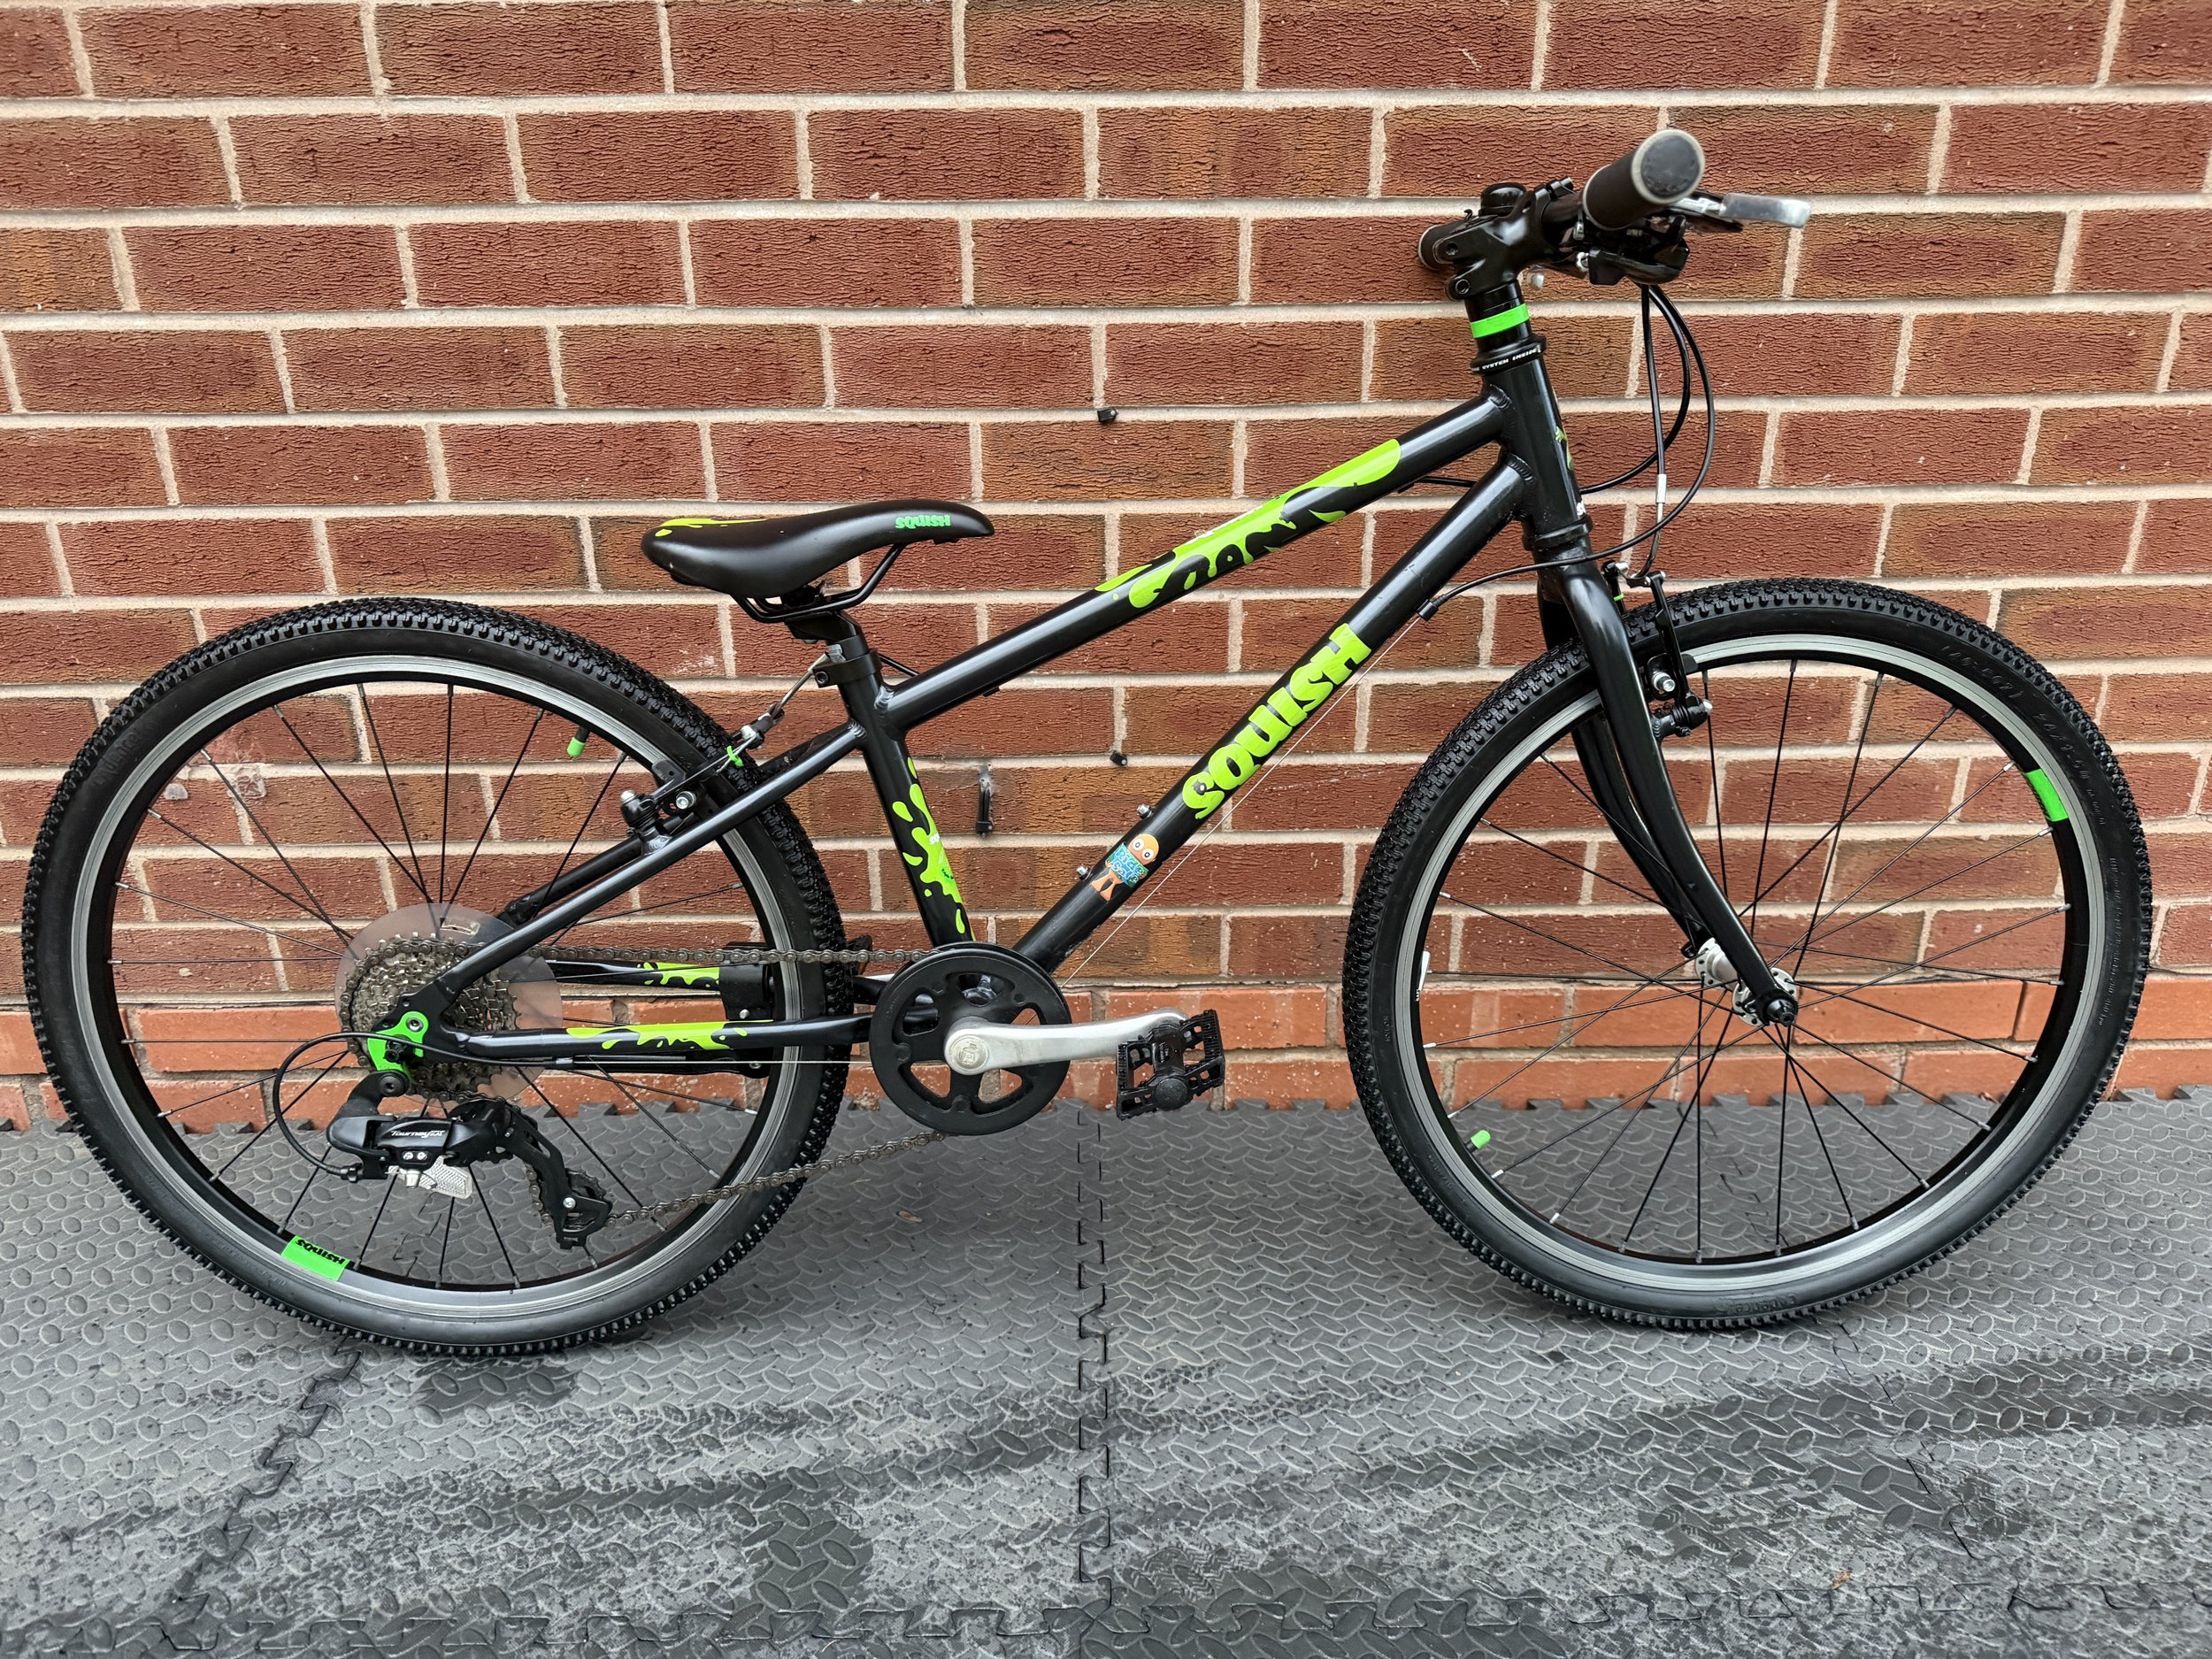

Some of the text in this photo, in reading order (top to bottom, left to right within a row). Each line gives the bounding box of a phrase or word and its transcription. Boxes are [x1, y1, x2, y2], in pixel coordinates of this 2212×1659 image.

[1482, 358, 1509, 370] SYSTEM
[895, 515, 950, 529] SQUISH
[1182, 623, 1371, 819] SQUISH
[296, 1239, 346, 1264] SQUISH
